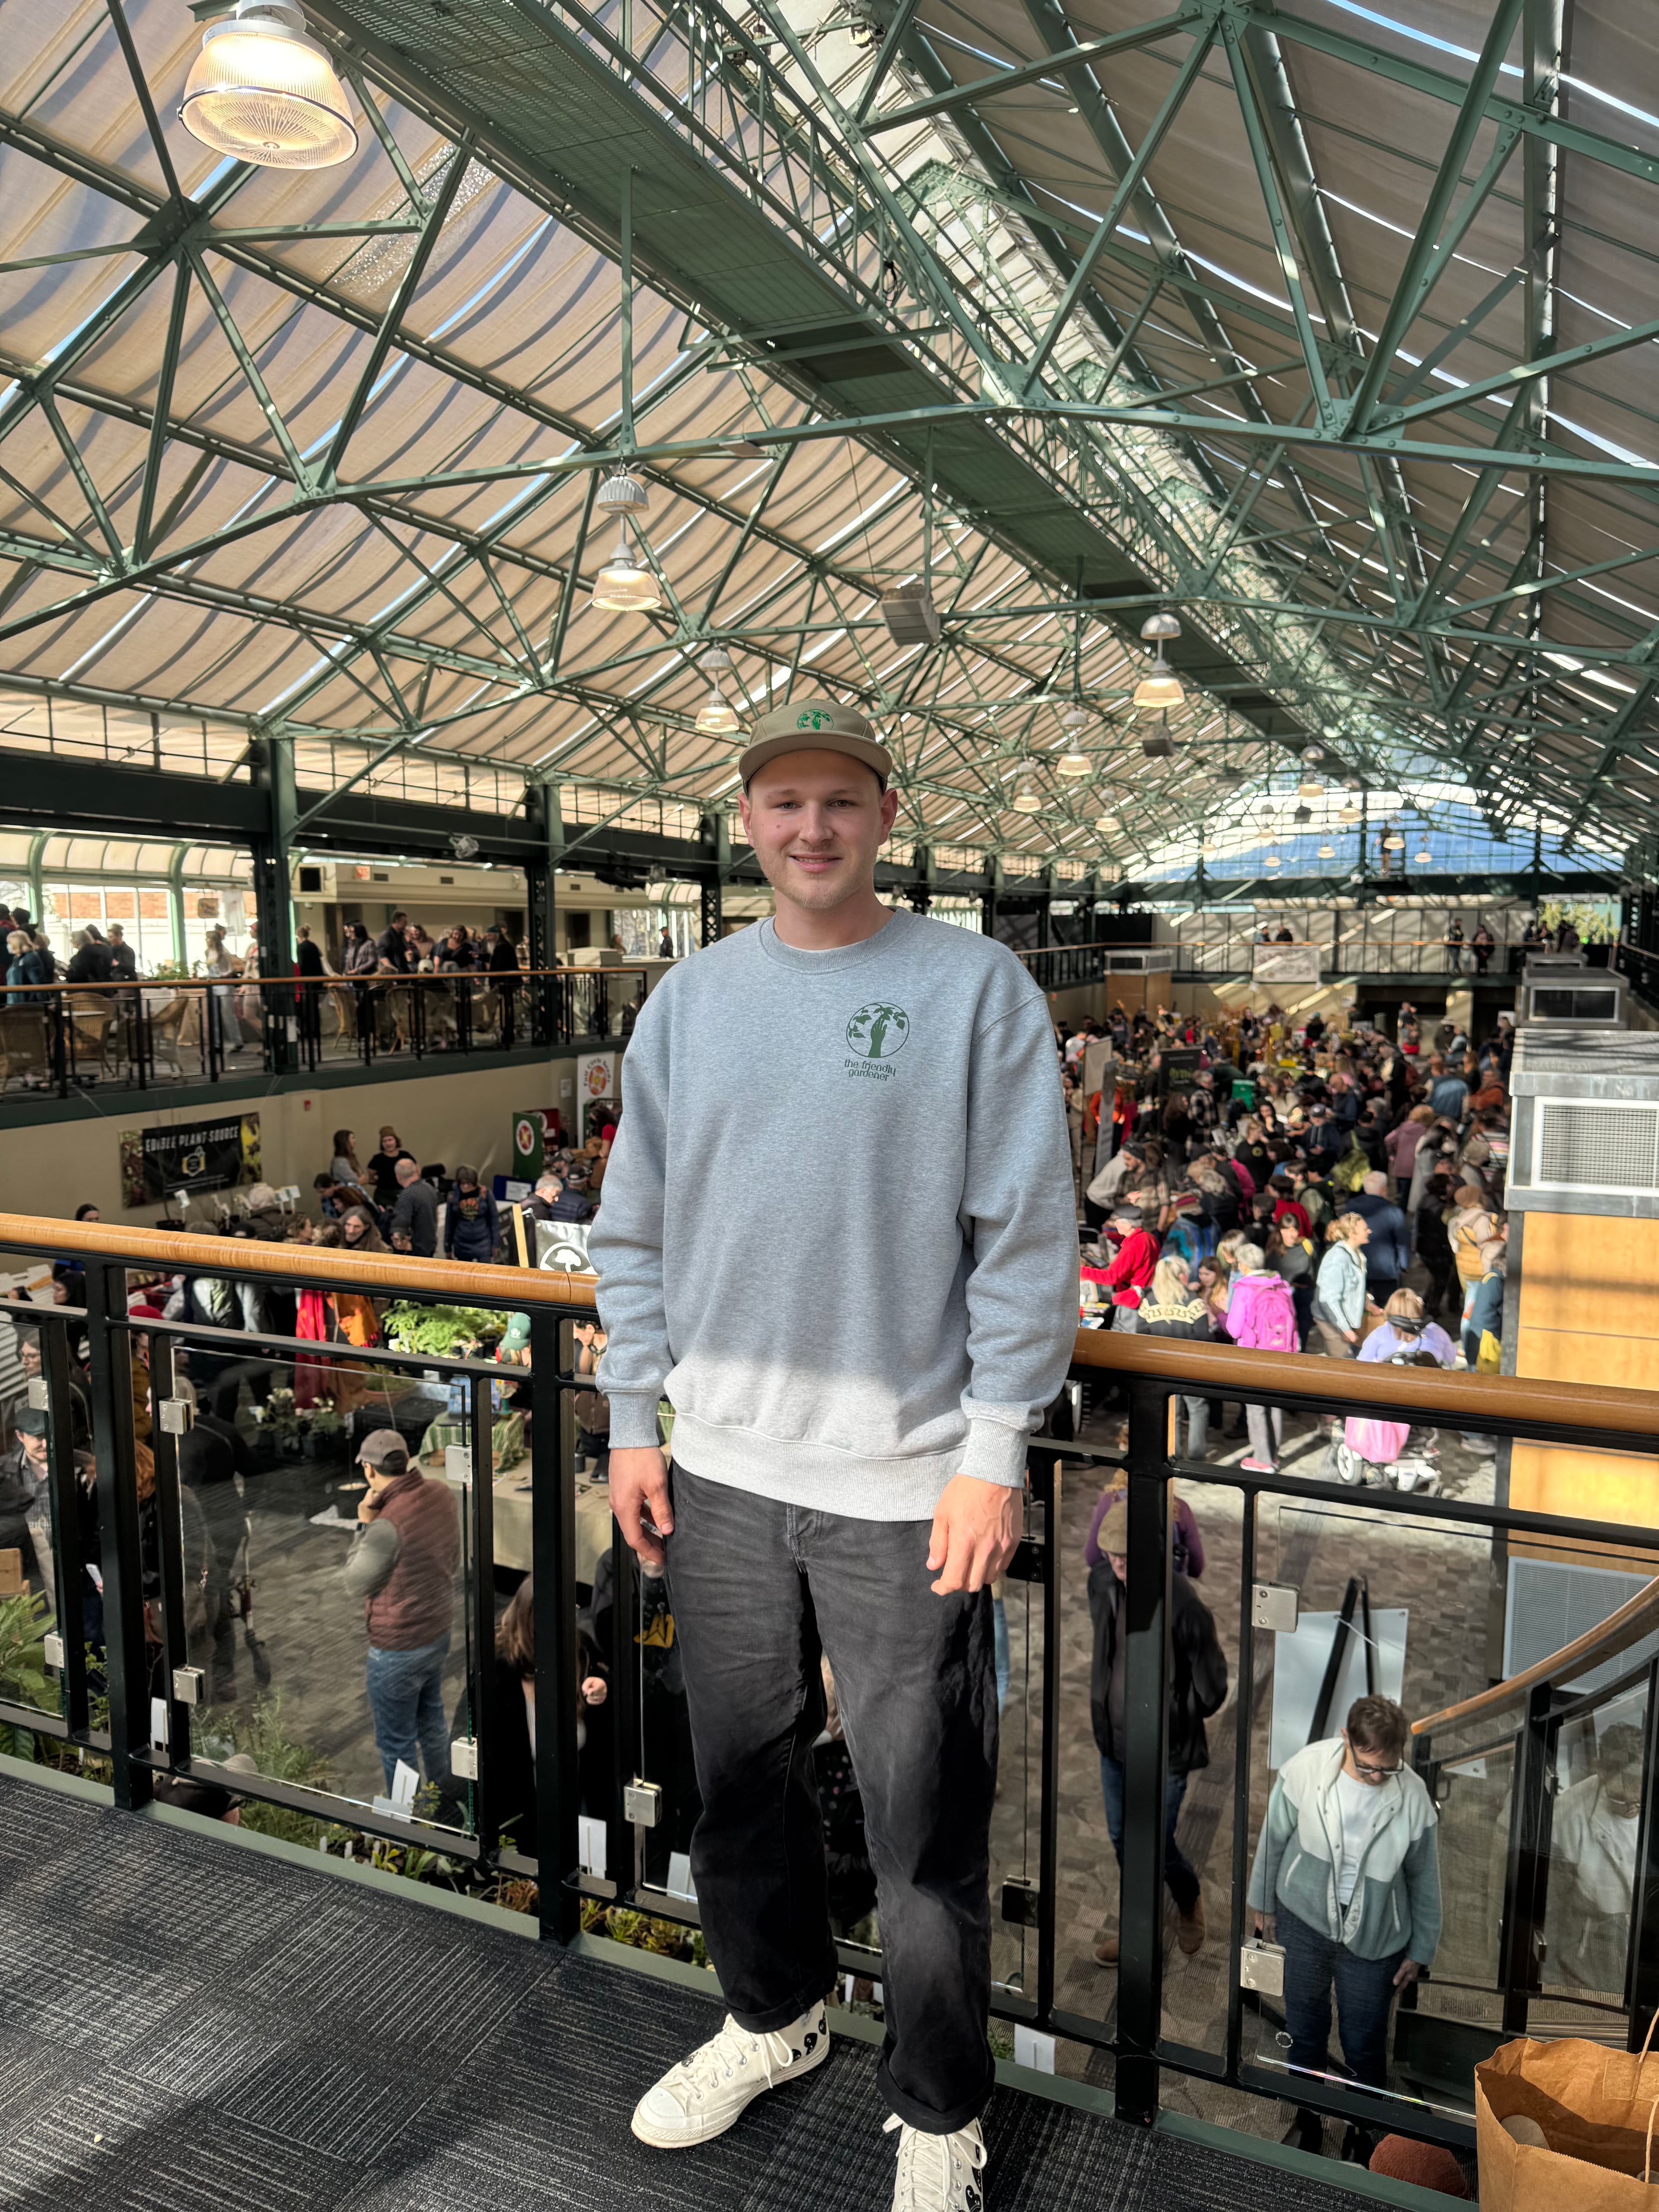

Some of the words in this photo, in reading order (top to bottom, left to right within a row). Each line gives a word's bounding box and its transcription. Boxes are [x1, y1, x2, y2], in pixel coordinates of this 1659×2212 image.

[845, 1059, 858, 1068] the
[861, 1061, 896, 1077] friendly
[849, 1069, 890, 1081] gardener
[178, 1131, 207, 1147] PLANT
[209, 1125, 239, 1143] SOURCE
